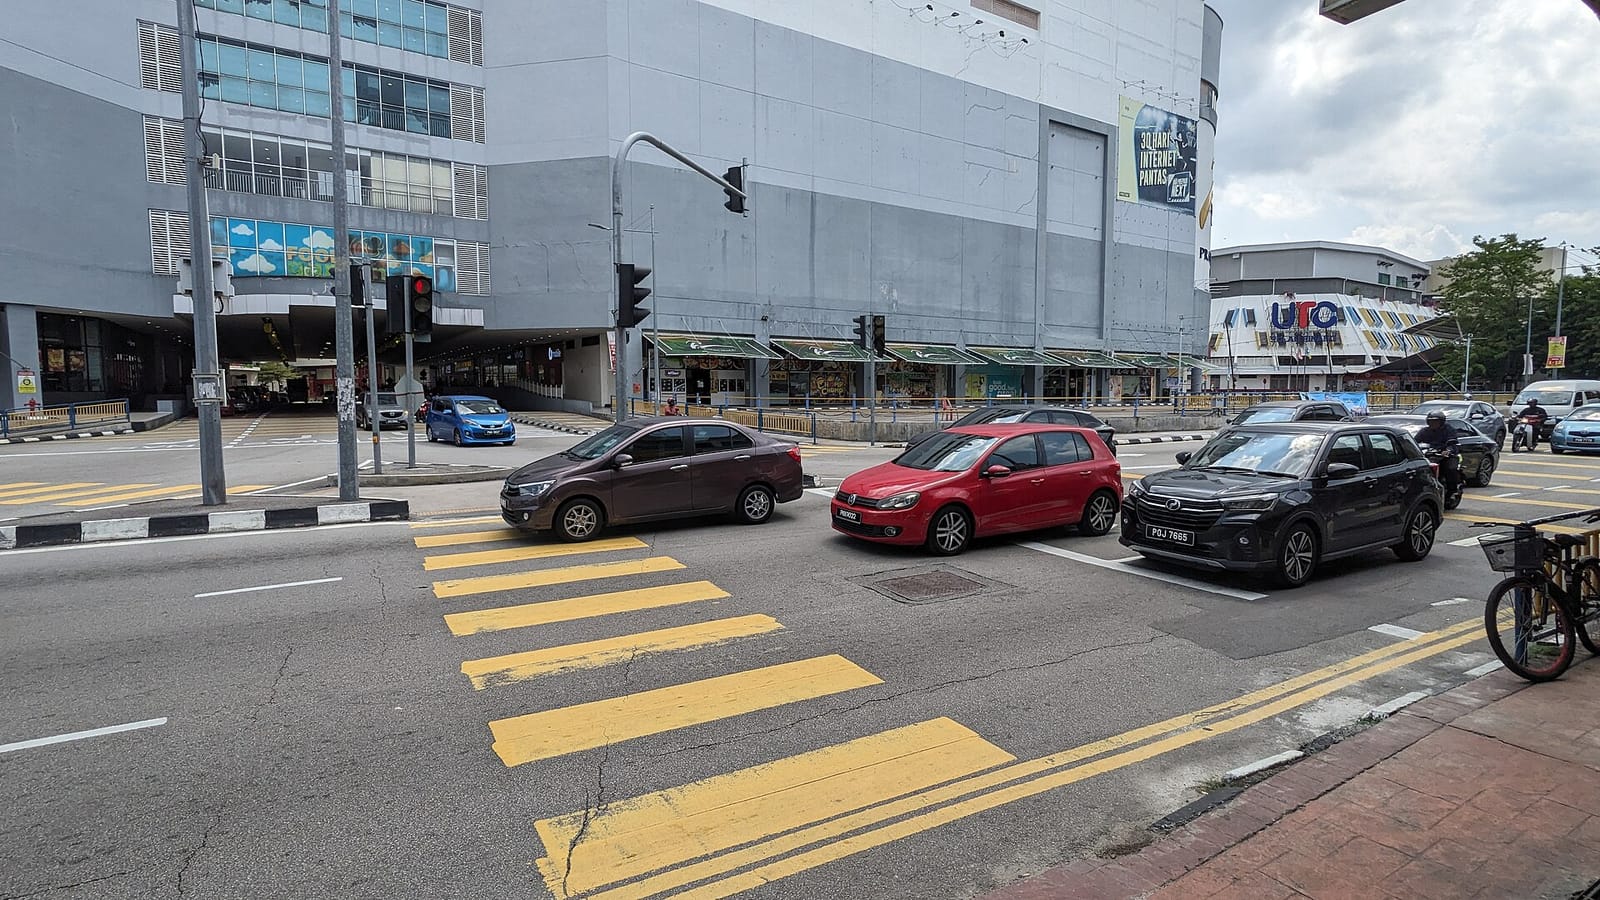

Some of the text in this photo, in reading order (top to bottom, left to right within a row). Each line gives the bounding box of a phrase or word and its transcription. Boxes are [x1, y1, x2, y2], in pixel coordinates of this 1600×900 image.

[1152, 131, 1170, 148] HARI
[1140, 150, 1177, 169] INTERNET
[1139, 168, 1168, 187] PANTAS
[1271, 301, 1338, 329] UTC
[1168, 530, 1188, 542] 7665
